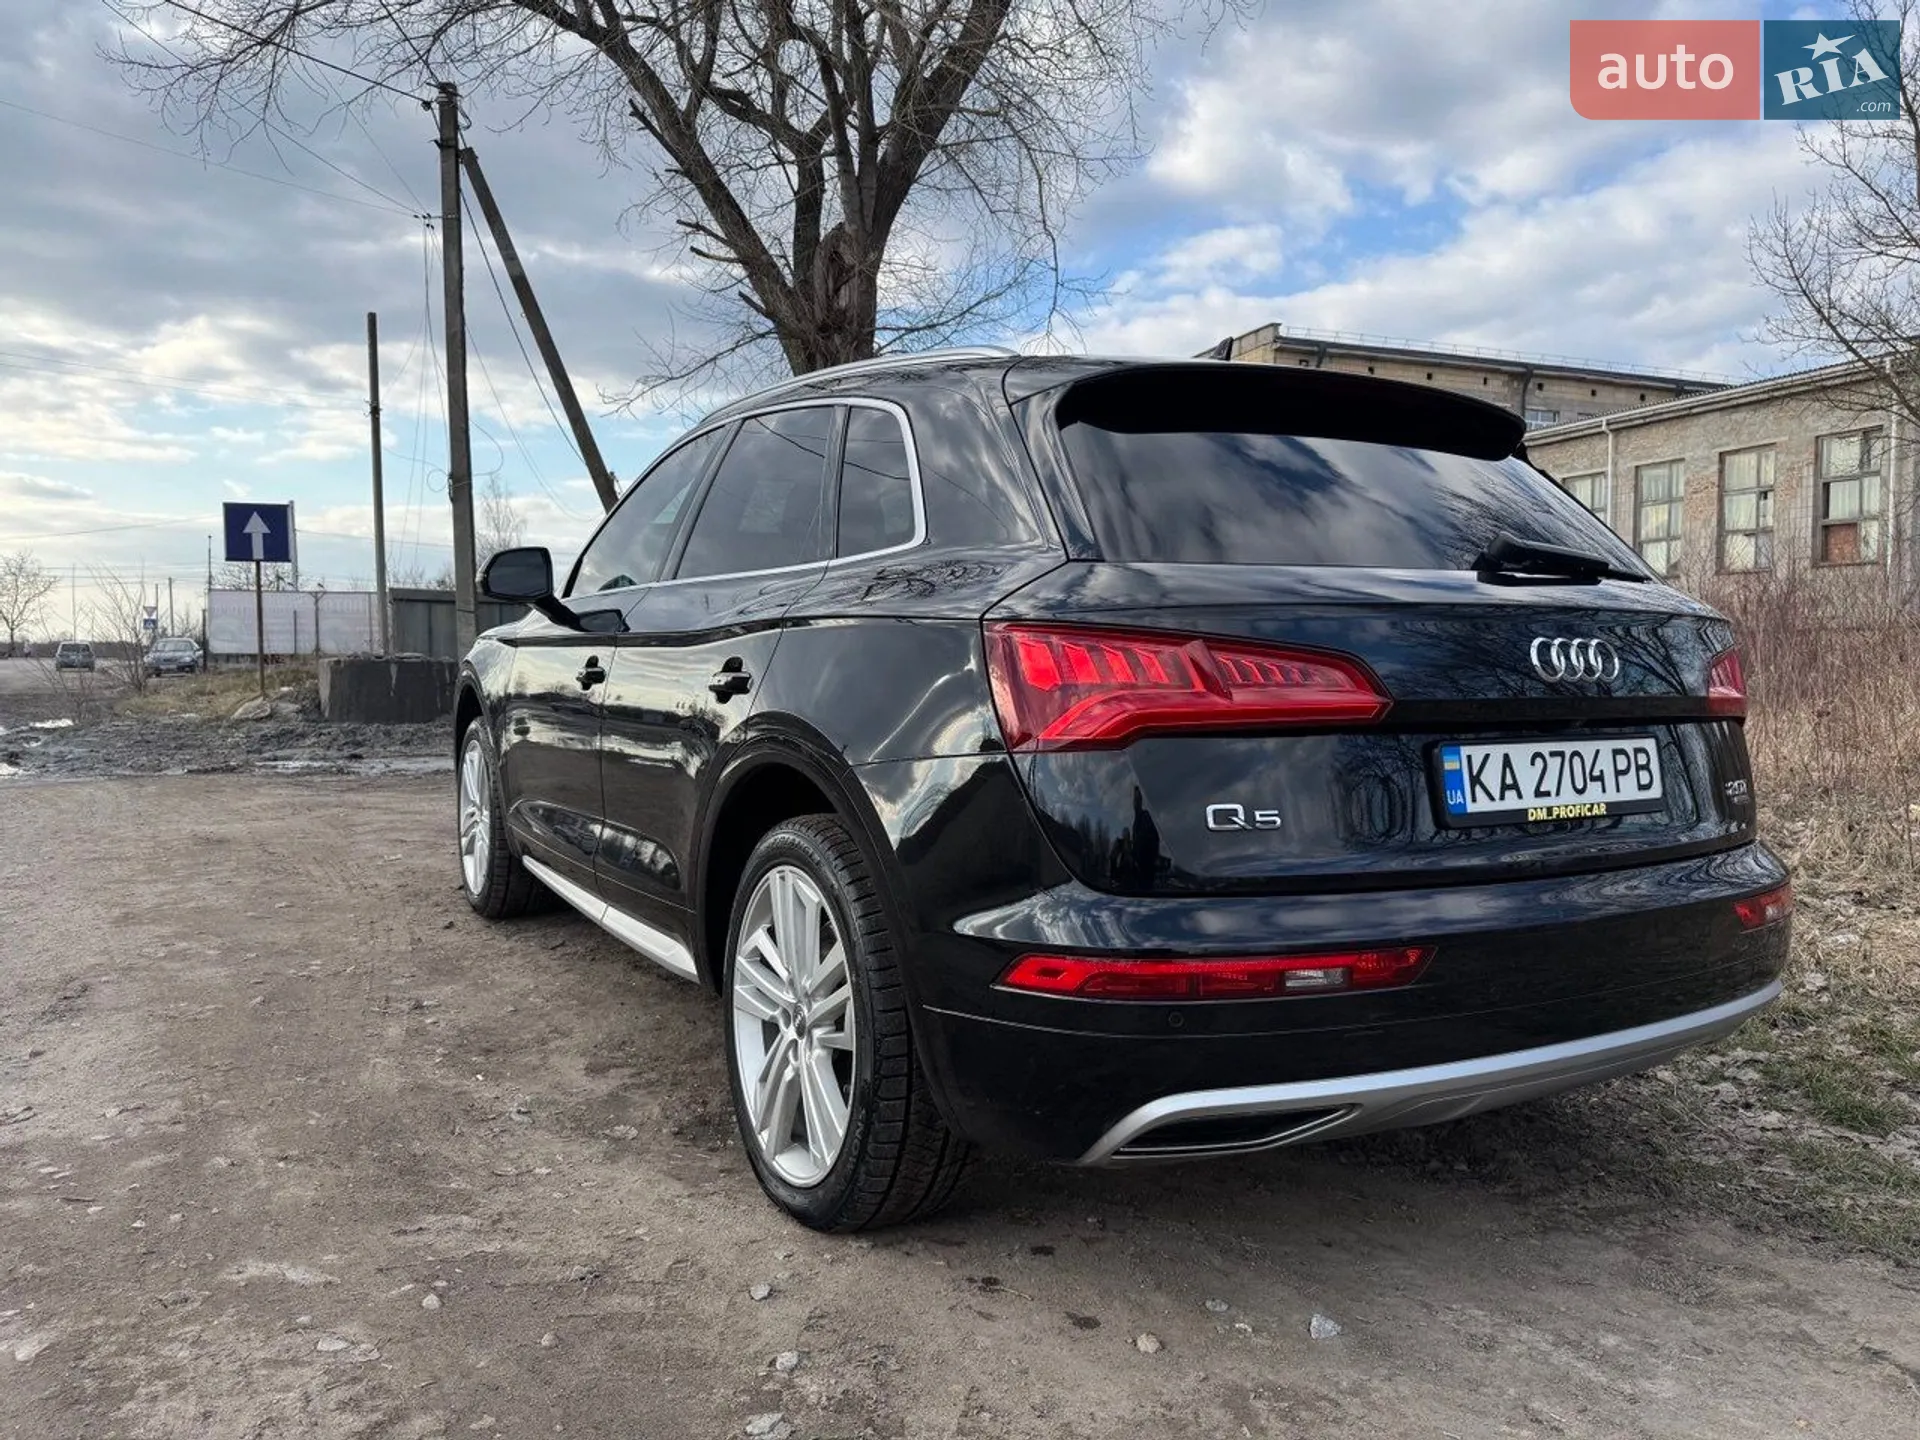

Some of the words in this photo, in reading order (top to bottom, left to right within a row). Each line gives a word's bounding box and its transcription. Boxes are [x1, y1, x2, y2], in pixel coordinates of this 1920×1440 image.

[1466, 752, 1523, 803] KA
[1530, 749, 1607, 798] 2704
[1611, 747, 1655, 792] PB
[1447, 789, 1465, 805] UA
[1206, 804, 1282, 831] Q5
